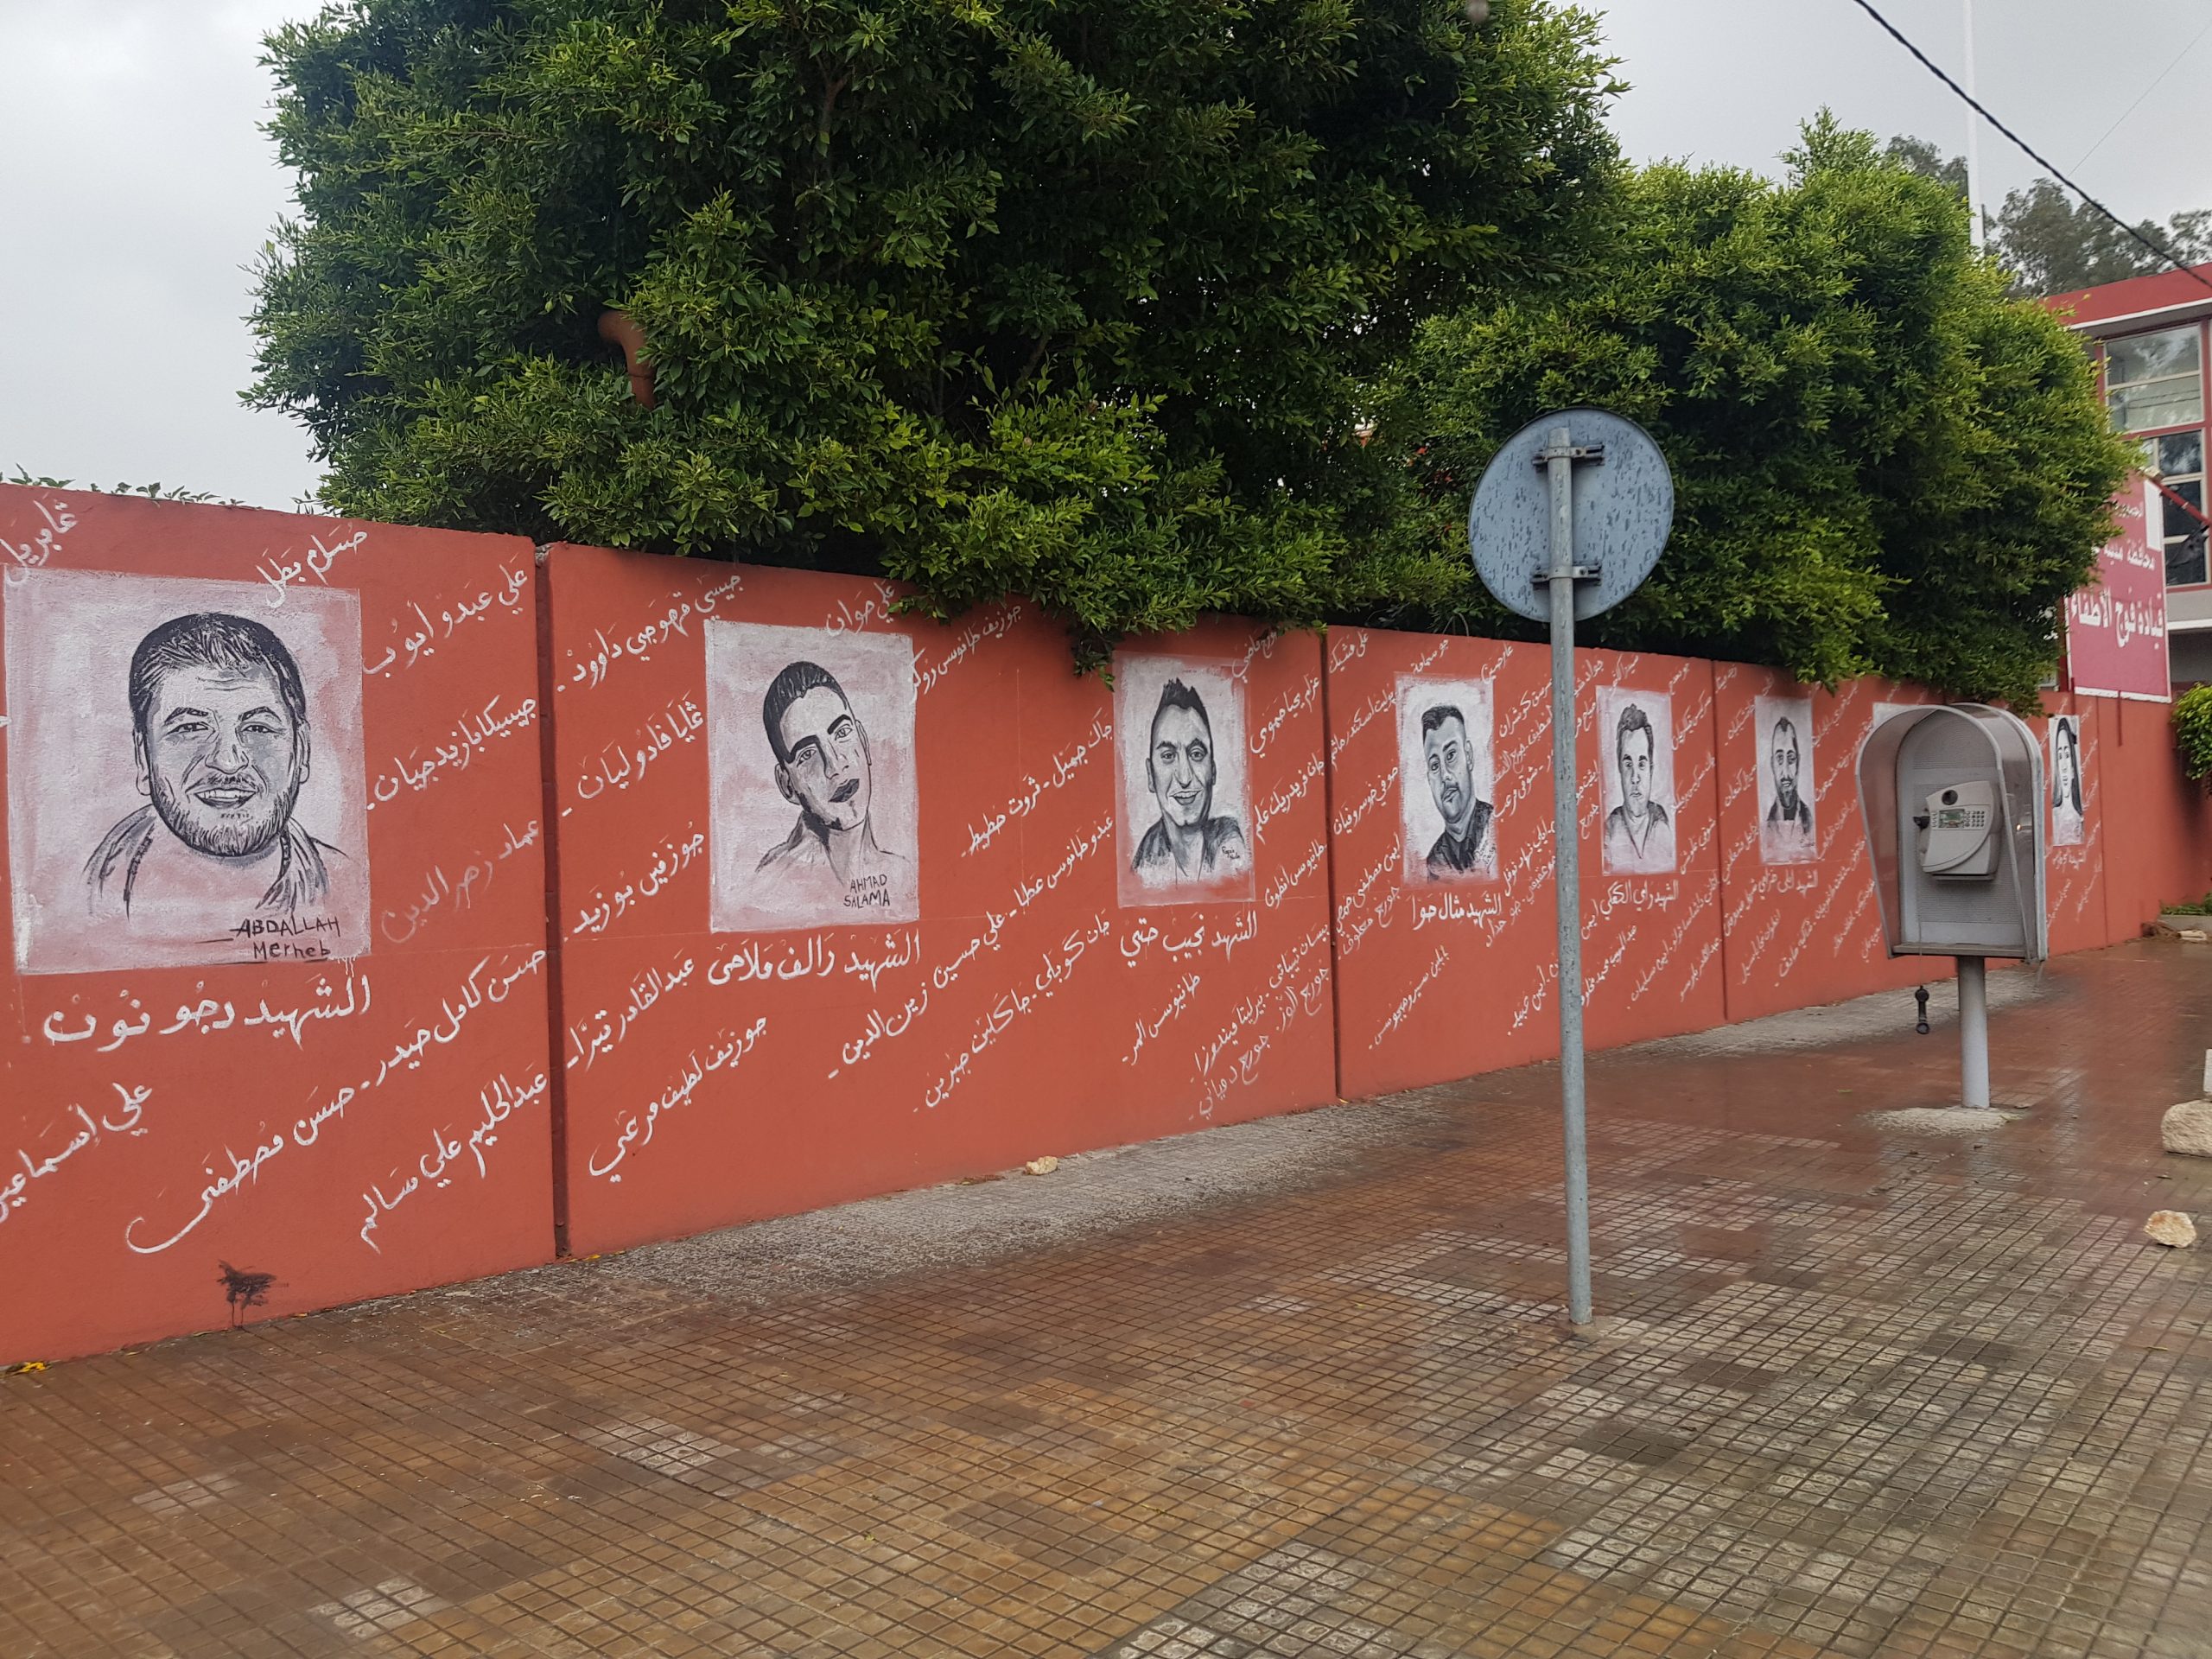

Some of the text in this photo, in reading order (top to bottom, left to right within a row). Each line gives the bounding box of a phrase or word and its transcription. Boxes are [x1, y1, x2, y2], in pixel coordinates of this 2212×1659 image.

[849, 874, 888, 893] AHMAD
[843, 891, 891, 908] SALAMA
[231, 917, 340, 938] ABDALLAH
[252, 941, 332, 960] Merheb
